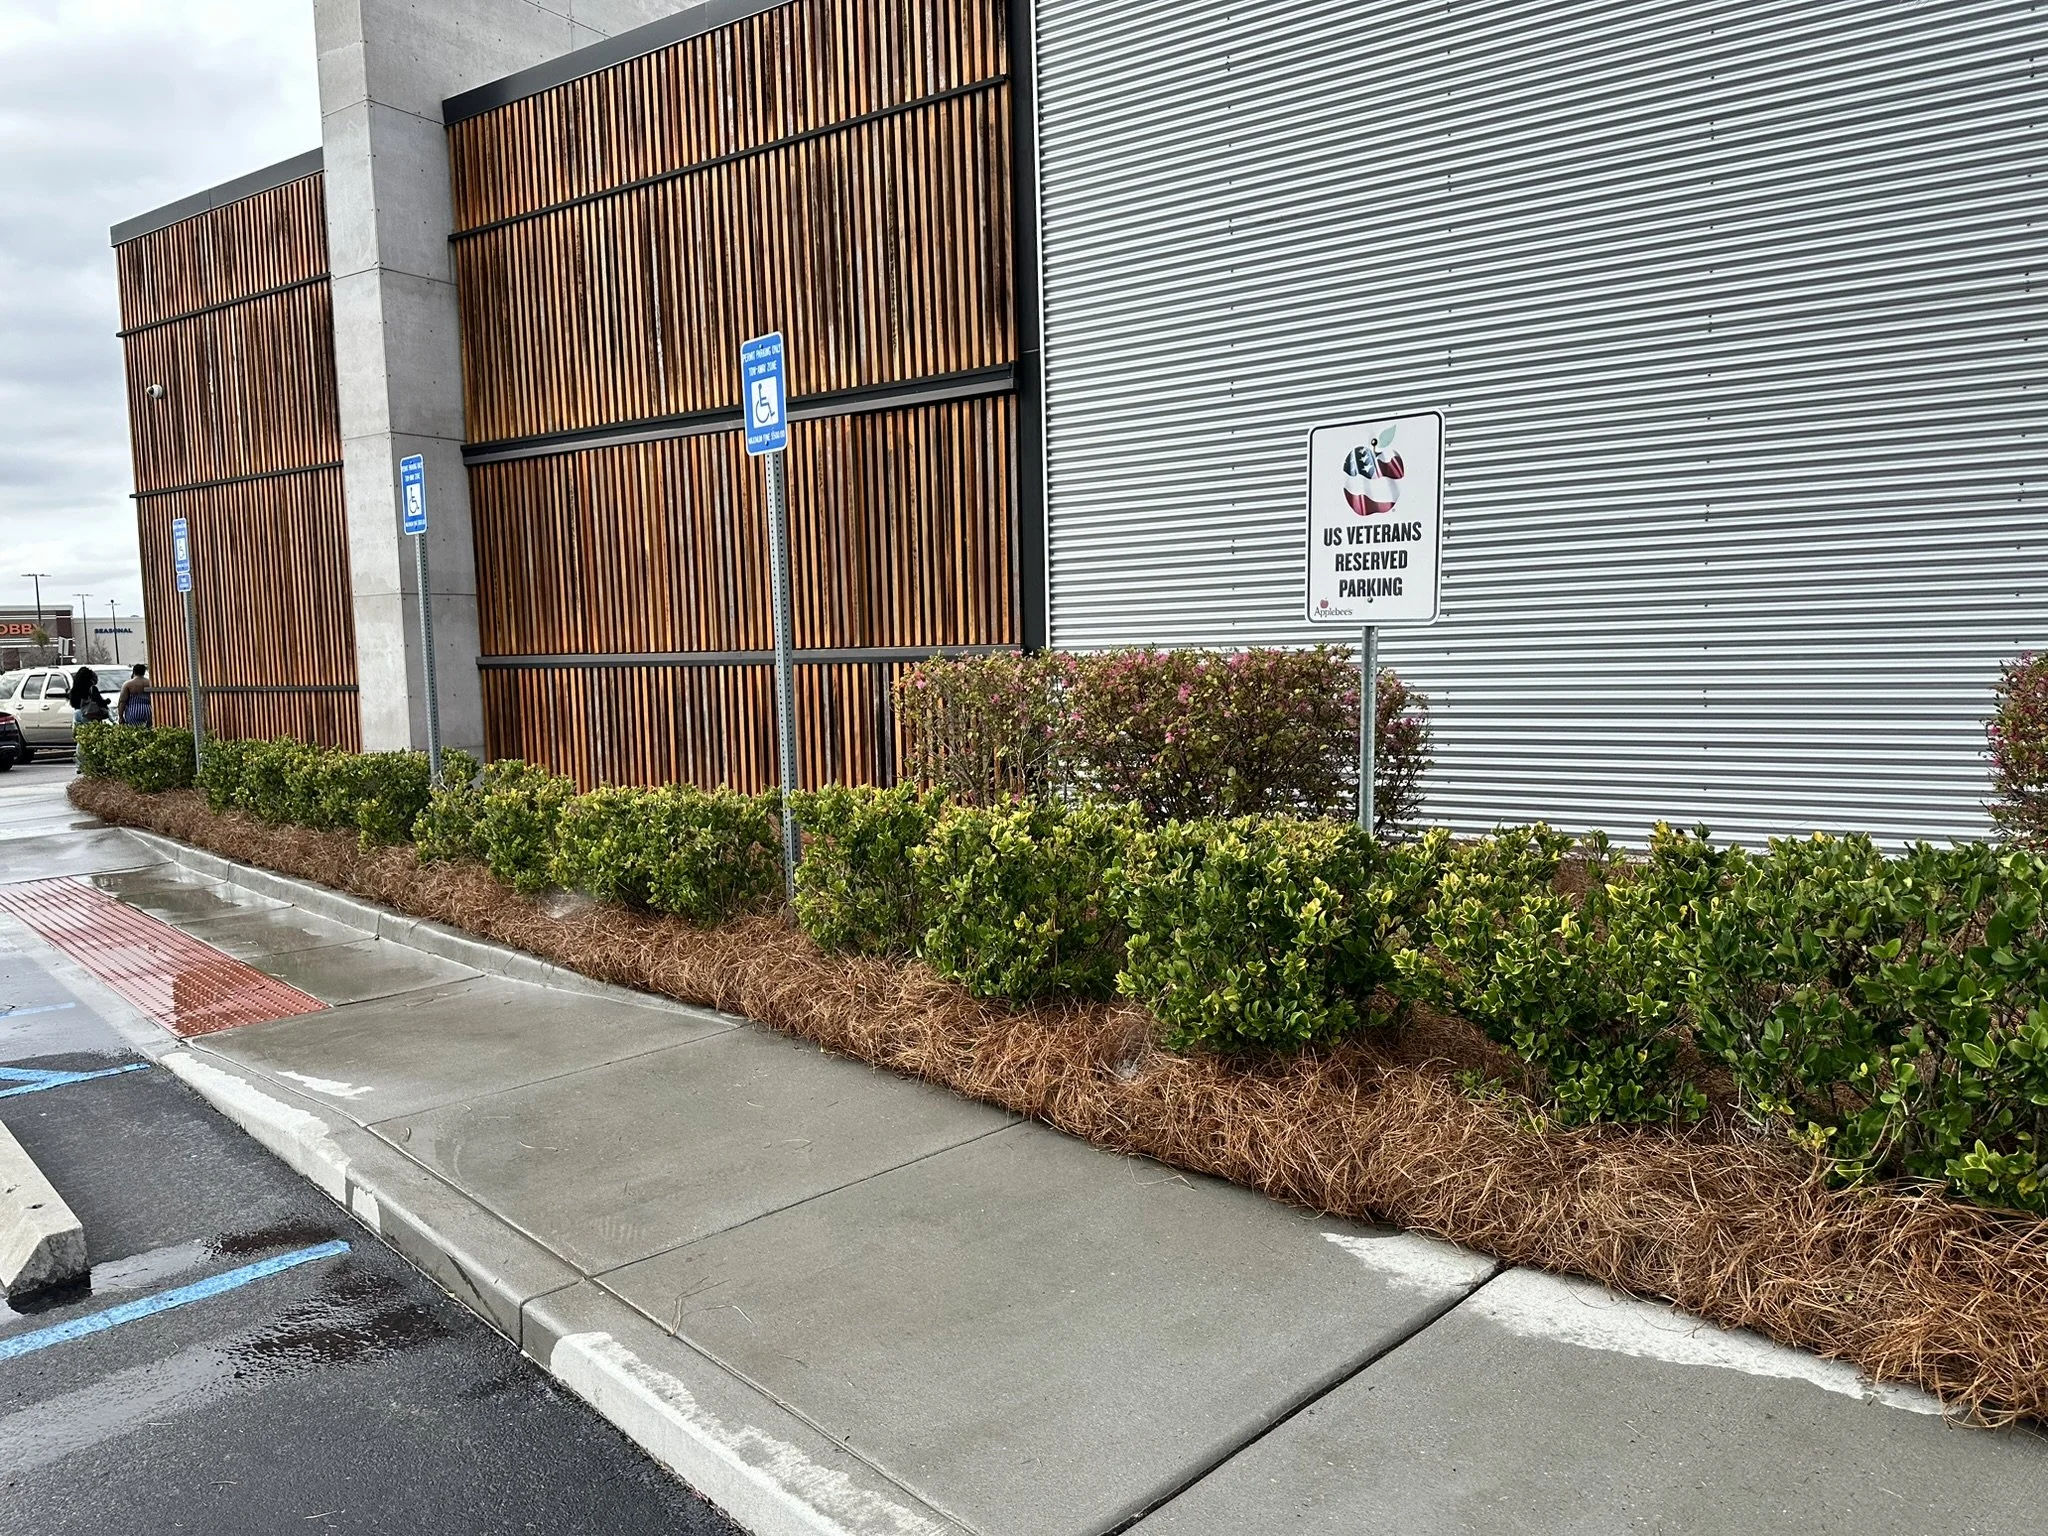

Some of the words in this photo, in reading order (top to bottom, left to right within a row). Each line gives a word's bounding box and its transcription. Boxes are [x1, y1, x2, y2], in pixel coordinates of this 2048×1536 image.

[767, 360, 777, 372] ZONE
[1324, 527, 1342, 546] US
[1346, 521, 1421, 545] VETERANS
[1335, 550, 1407, 572] RESERVED
[1339, 577, 1402, 598] PARKING
